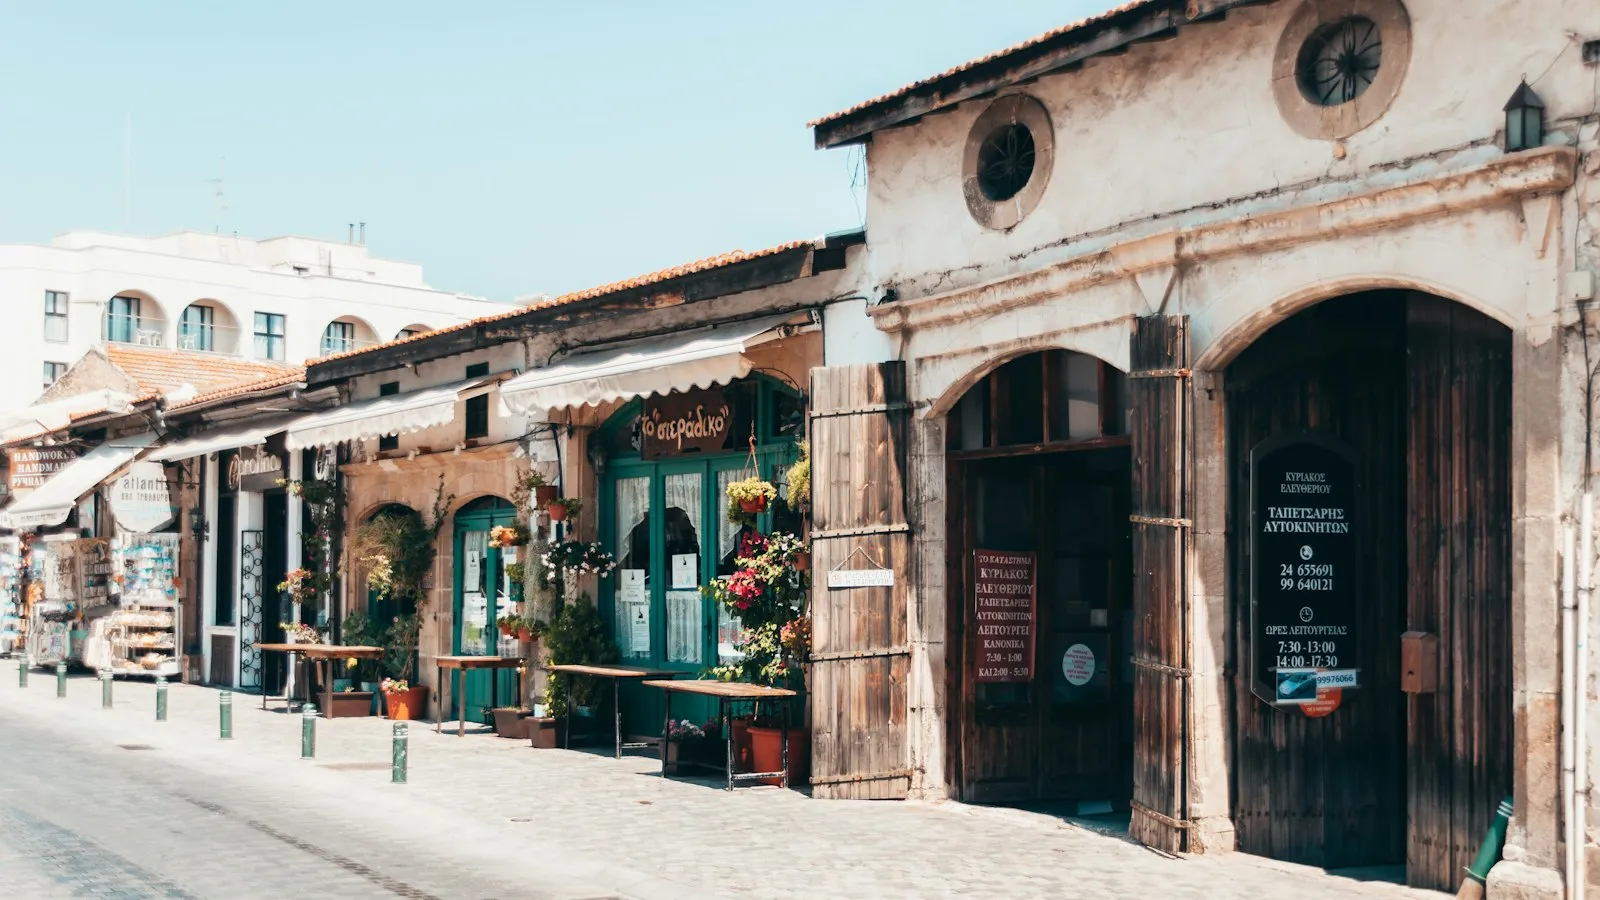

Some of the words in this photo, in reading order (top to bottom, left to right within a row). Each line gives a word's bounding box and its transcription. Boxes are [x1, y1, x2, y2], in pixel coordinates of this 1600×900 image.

[17, 462, 68, 473] HANDMAD
[1285, 472, 1326, 482] ΚΥΡΙΑΚΟΣ
[1280, 483, 1331, 494] ΕΛΕΥΘΕΡΙΟΥ
[1267, 507, 1344, 519] ΤΑΠΕΤΣΑΡΗΣ
[1263, 521, 1349, 533] ΑΥΤΟΚΙΝΗΤΩΝ
[989, 556, 1032, 565] ΚΑΤΑΣΤΗΜΑ
[980, 568, 1029, 580] ΚΥΡΙΑΚΟΣ
[1280, 564, 1293, 576] 24
[1297, 564, 1333, 576] 655691
[975, 583, 1033, 594] ΕΛΕΥΘΕΡΙΟΥ
[1280, 578, 1293, 591] 99
[1297, 578, 1333, 591] 640121
[978, 598, 1030, 607] ΤΑΠΕΤΣΑΡΙΕΣ
[976, 611, 1032, 621] ΑΥΤΟΚΙΝΗΤΩΝ
[977, 625, 1029, 635] ΛΕΙΤΟΥΡΓΕΙ
[1265, 625, 1288, 635] ΩΡΕΣ
[1288, 625, 1347, 635] ΛΕΙΤΟΥΡΓΕΙΑΣ
[984, 640, 1025, 649] ΚΑΝΟΝΙΚΑ
[986, 653, 1002, 662] 7:30
[1008, 653, 1023, 662] 1:00
[979, 668, 992, 677] ΚΑΙ
[993, 667, 1008, 676] 2:00
[1013, 667, 1029, 676] 5:30
[1316, 674, 1354, 684] 99976066
